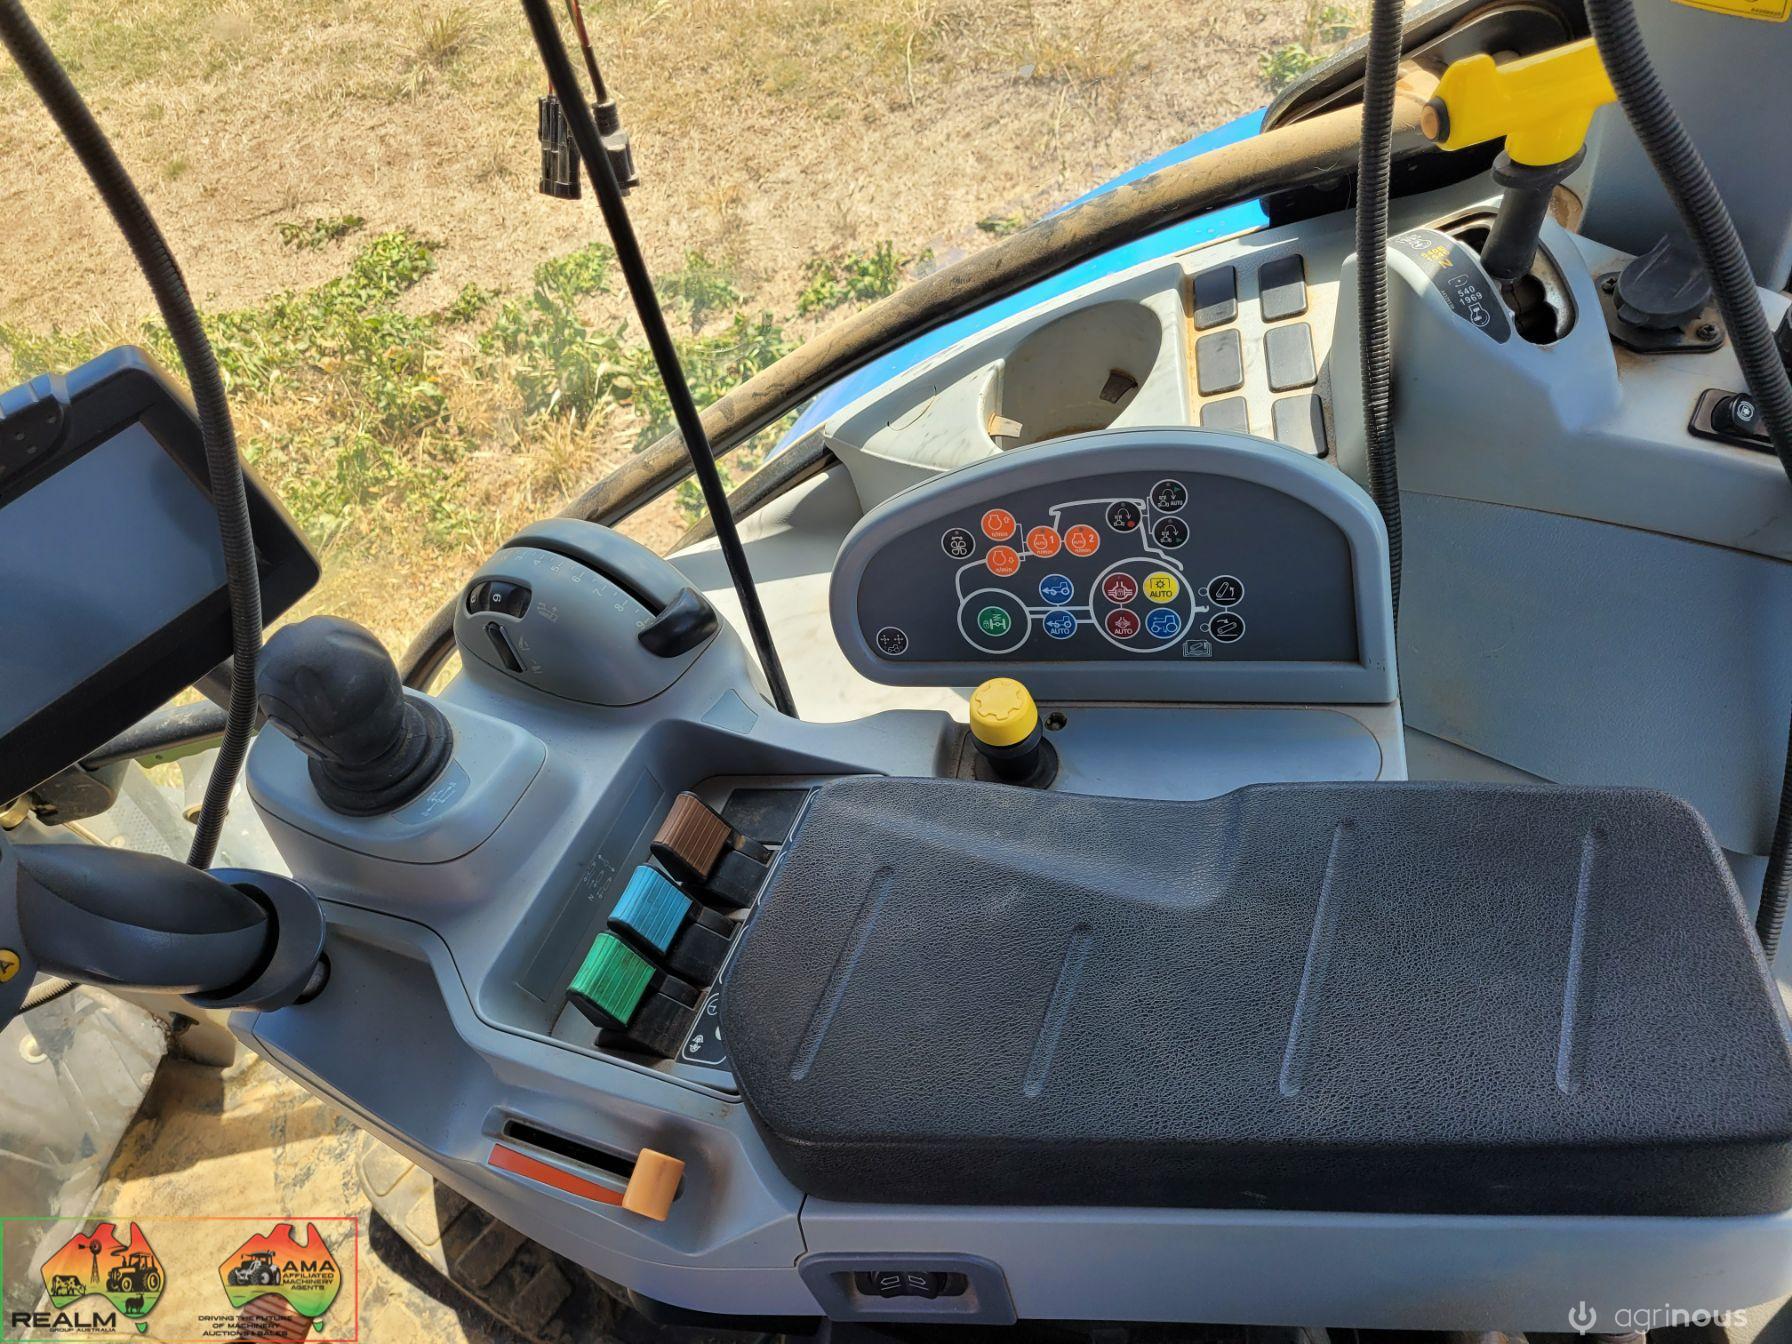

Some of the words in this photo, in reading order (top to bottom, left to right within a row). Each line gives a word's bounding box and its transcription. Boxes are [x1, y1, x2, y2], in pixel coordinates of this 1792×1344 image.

[1457, 286, 1475, 298] 540
[1459, 293, 1483, 306] 1969
[1049, 536, 1055, 544] 1
[614, 603, 624, 612] 8
